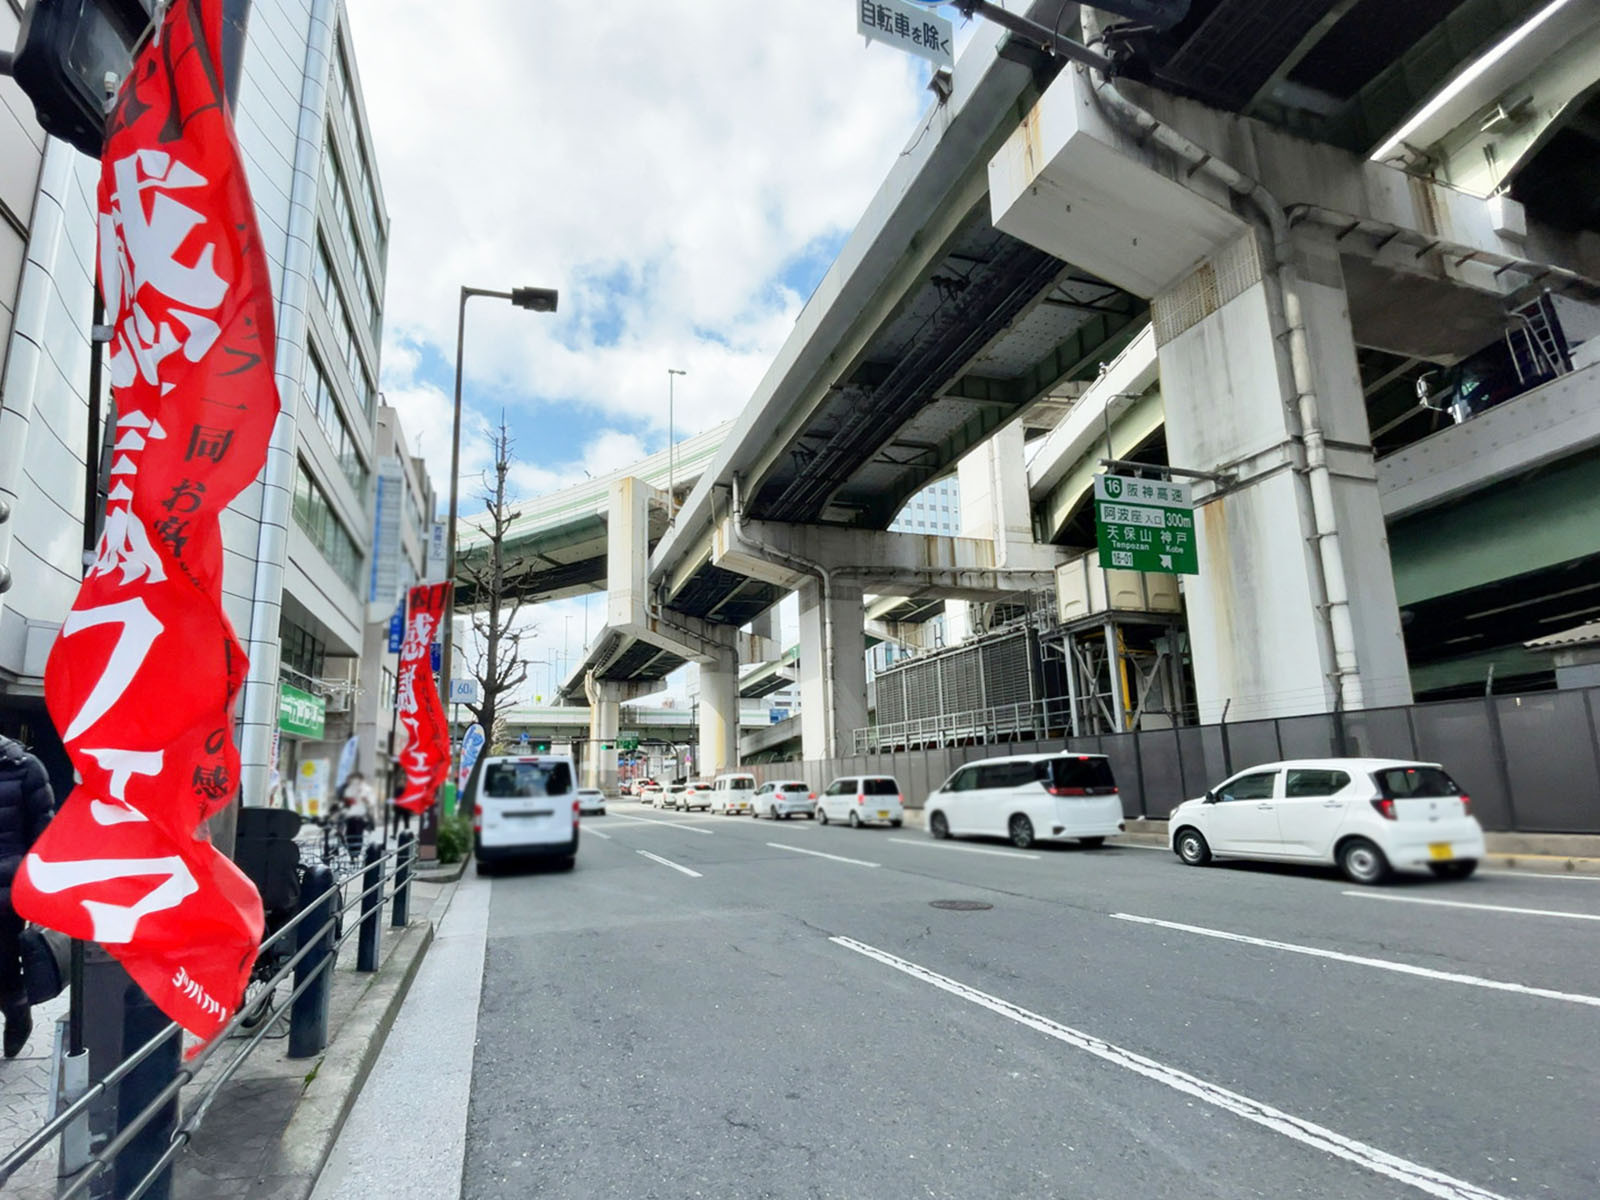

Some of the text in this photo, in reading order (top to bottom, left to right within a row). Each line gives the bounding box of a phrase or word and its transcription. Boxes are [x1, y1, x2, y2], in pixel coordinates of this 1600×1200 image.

[861, 0, 951, 56] 自転車を除く
[1106, 479, 1121, 494] 16
[1126, 483, 1184, 503] 阪神高速
[1166, 512, 1192, 528] 300m
[1107, 524, 1187, 545] 天保山 神戸
